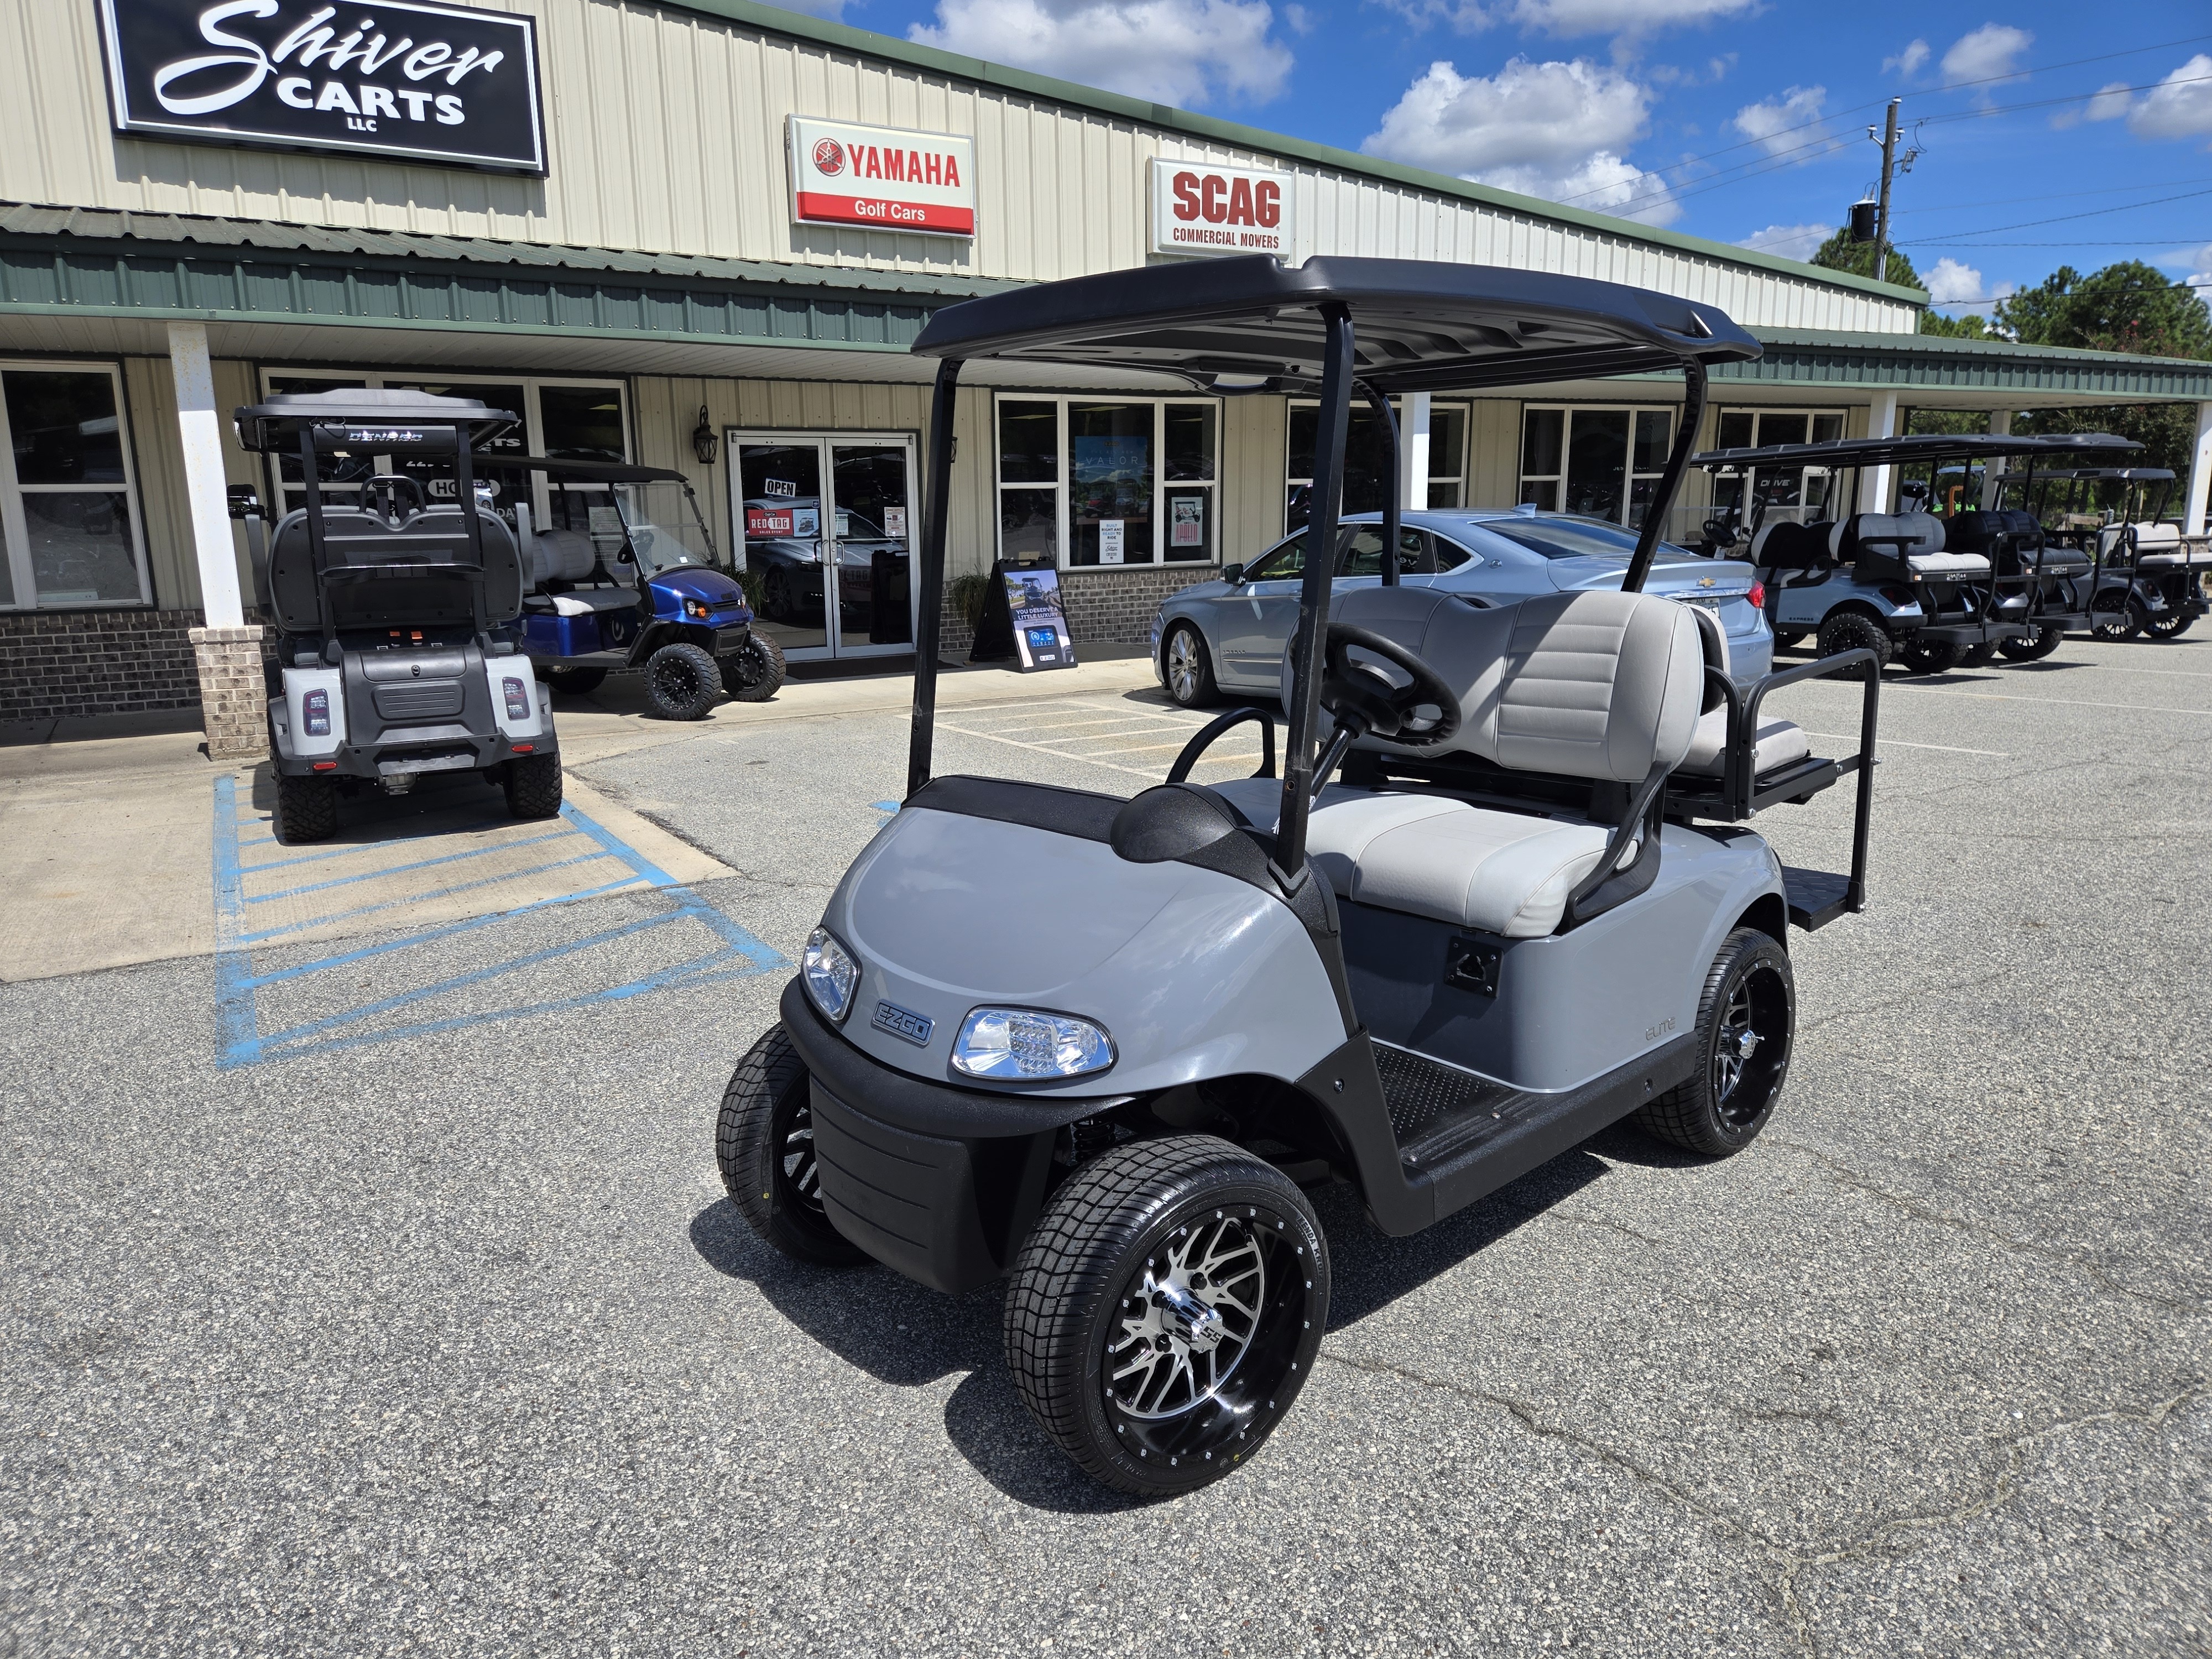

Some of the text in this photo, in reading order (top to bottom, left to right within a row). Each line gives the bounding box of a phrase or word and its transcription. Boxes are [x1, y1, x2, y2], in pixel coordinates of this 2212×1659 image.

[154, 0, 504, 115] Shiver
[276, 77, 465, 126] CARTS
[347, 117, 377, 133] LLC
[847, 143, 961, 187] YAMAHA
[1173, 171, 1280, 228] SCAG
[854, 200, 926, 221] Golf Cars
[1173, 227, 1279, 249] COMMERCIAL MOWERS
[1086, 456, 1138, 465] VALOR
[767, 480, 794, 496] OPEN
[751, 519, 787, 529] RED TAG
[1176, 524, 1198, 542] APOLLO
[875, 1003, 930, 1041] EZGO
